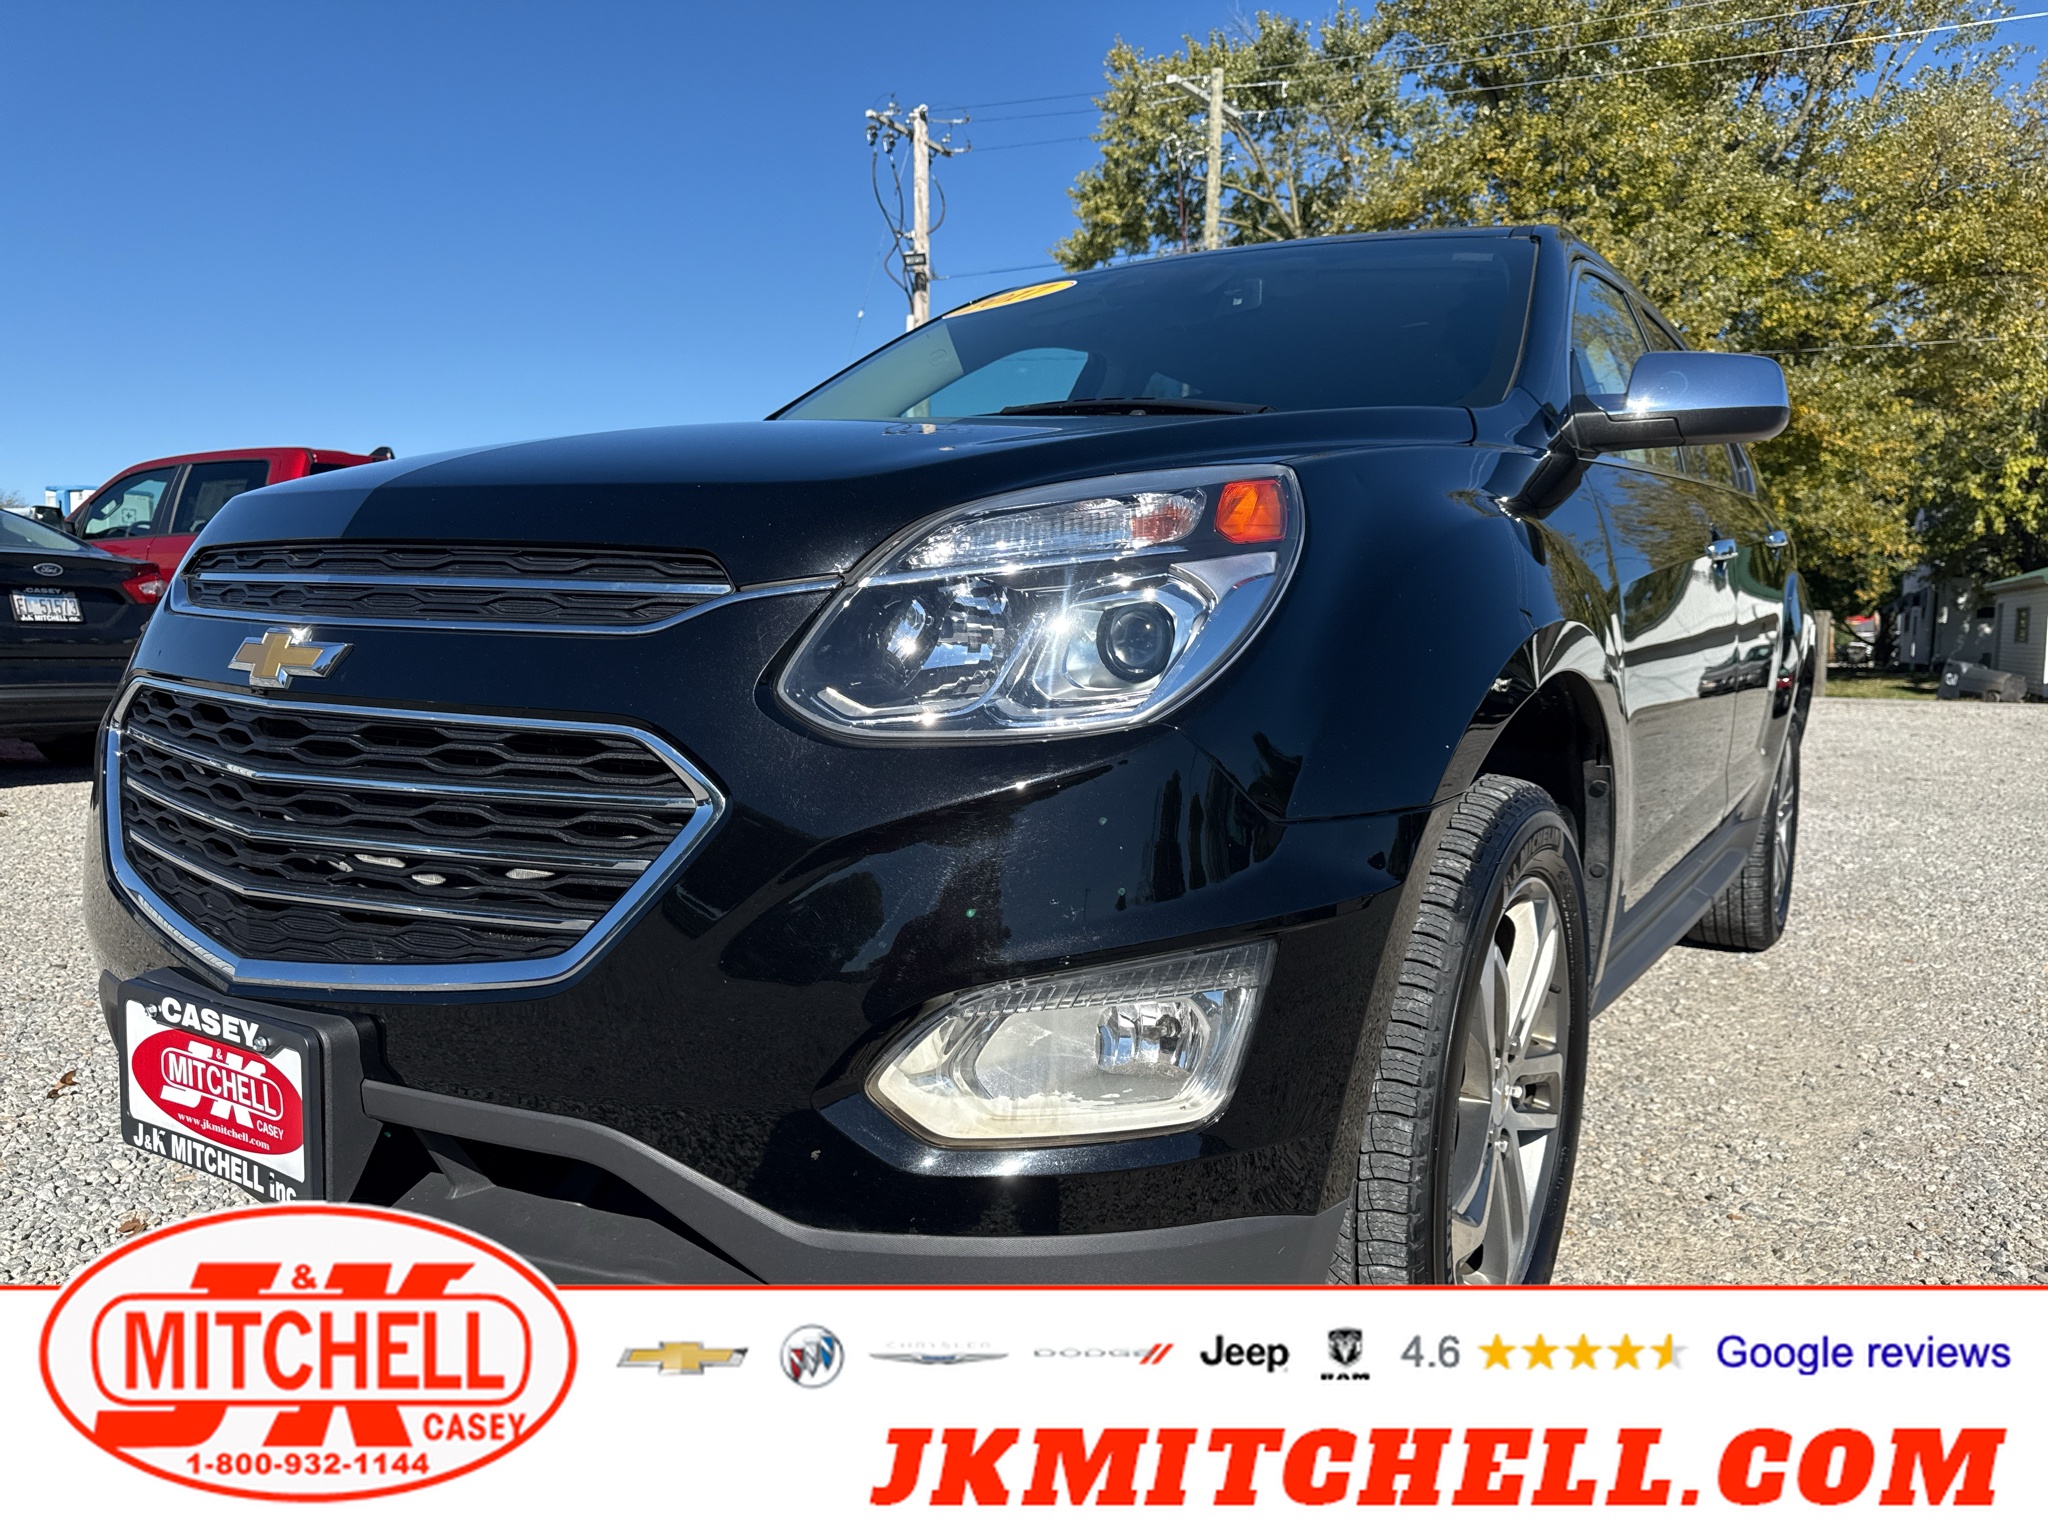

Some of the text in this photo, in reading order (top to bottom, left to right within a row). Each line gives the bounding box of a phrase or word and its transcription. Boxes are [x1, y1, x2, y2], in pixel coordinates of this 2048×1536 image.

[161, 997, 259, 1048] CASEY
[168, 1053, 277, 1116] MITCHELL
[177, 1112, 270, 1150] www.jkmitchell.com
[256, 1119, 284, 1140] CASEY
[133, 1122, 166, 1156] J&K
[171, 1133, 265, 1194] MITCHELL
